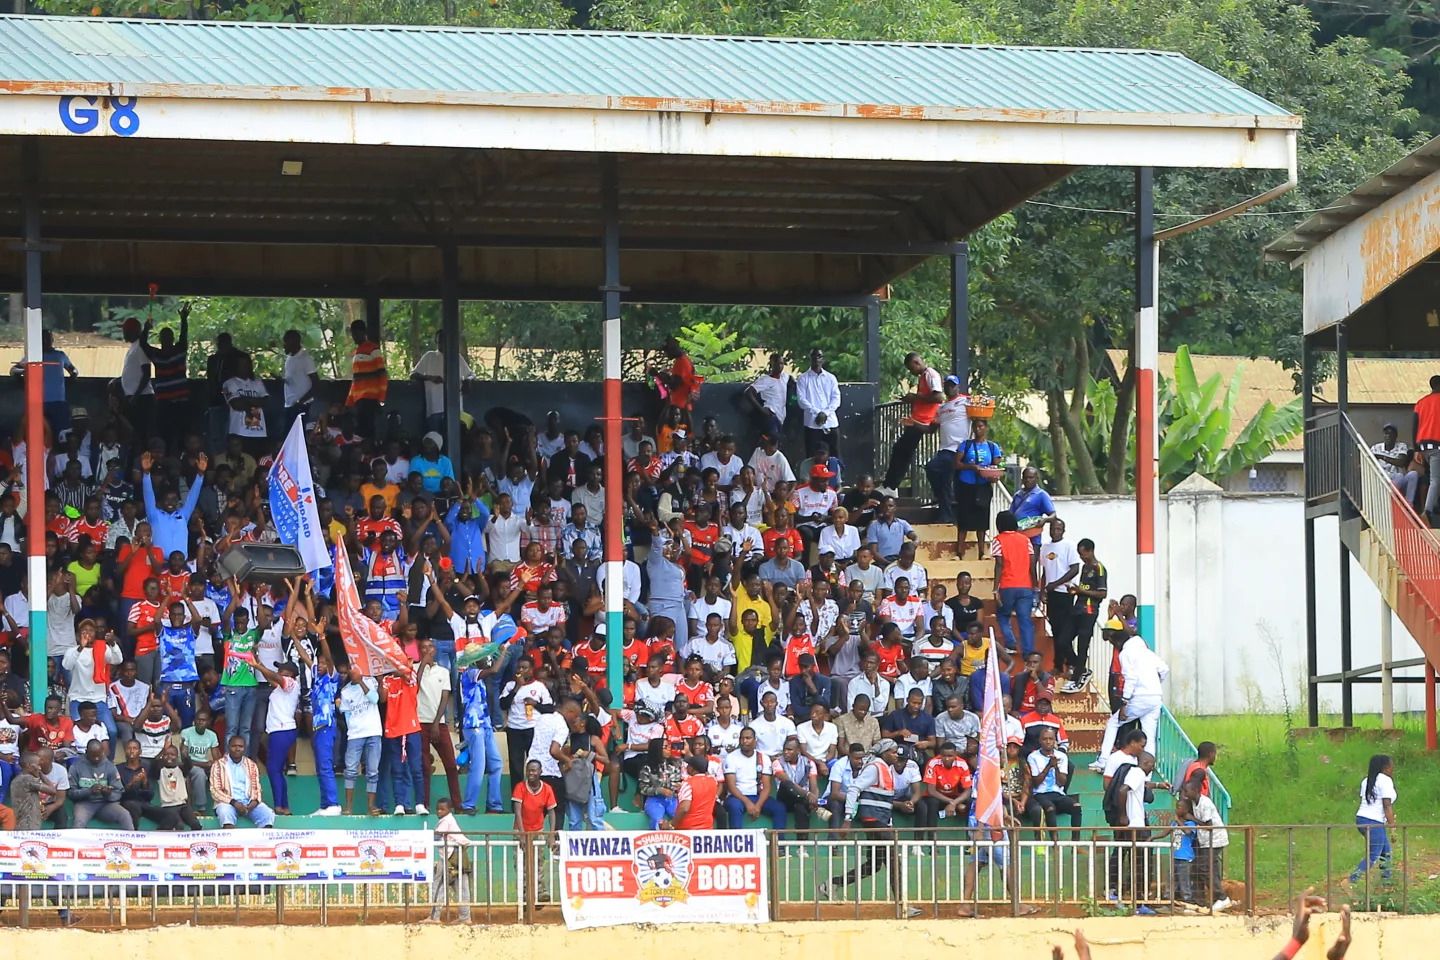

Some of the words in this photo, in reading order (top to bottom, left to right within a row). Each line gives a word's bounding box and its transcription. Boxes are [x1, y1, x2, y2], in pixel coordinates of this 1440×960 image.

[59, 95, 140, 136] G8
[568, 836, 632, 857] NYANZA
[693, 834, 754, 854] BRANCH
[640, 835, 672, 846] SHABANA
[672, 836, 683, 844] FC
[567, 866, 624, 893] TORE
[697, 864, 757, 891] BOBE
